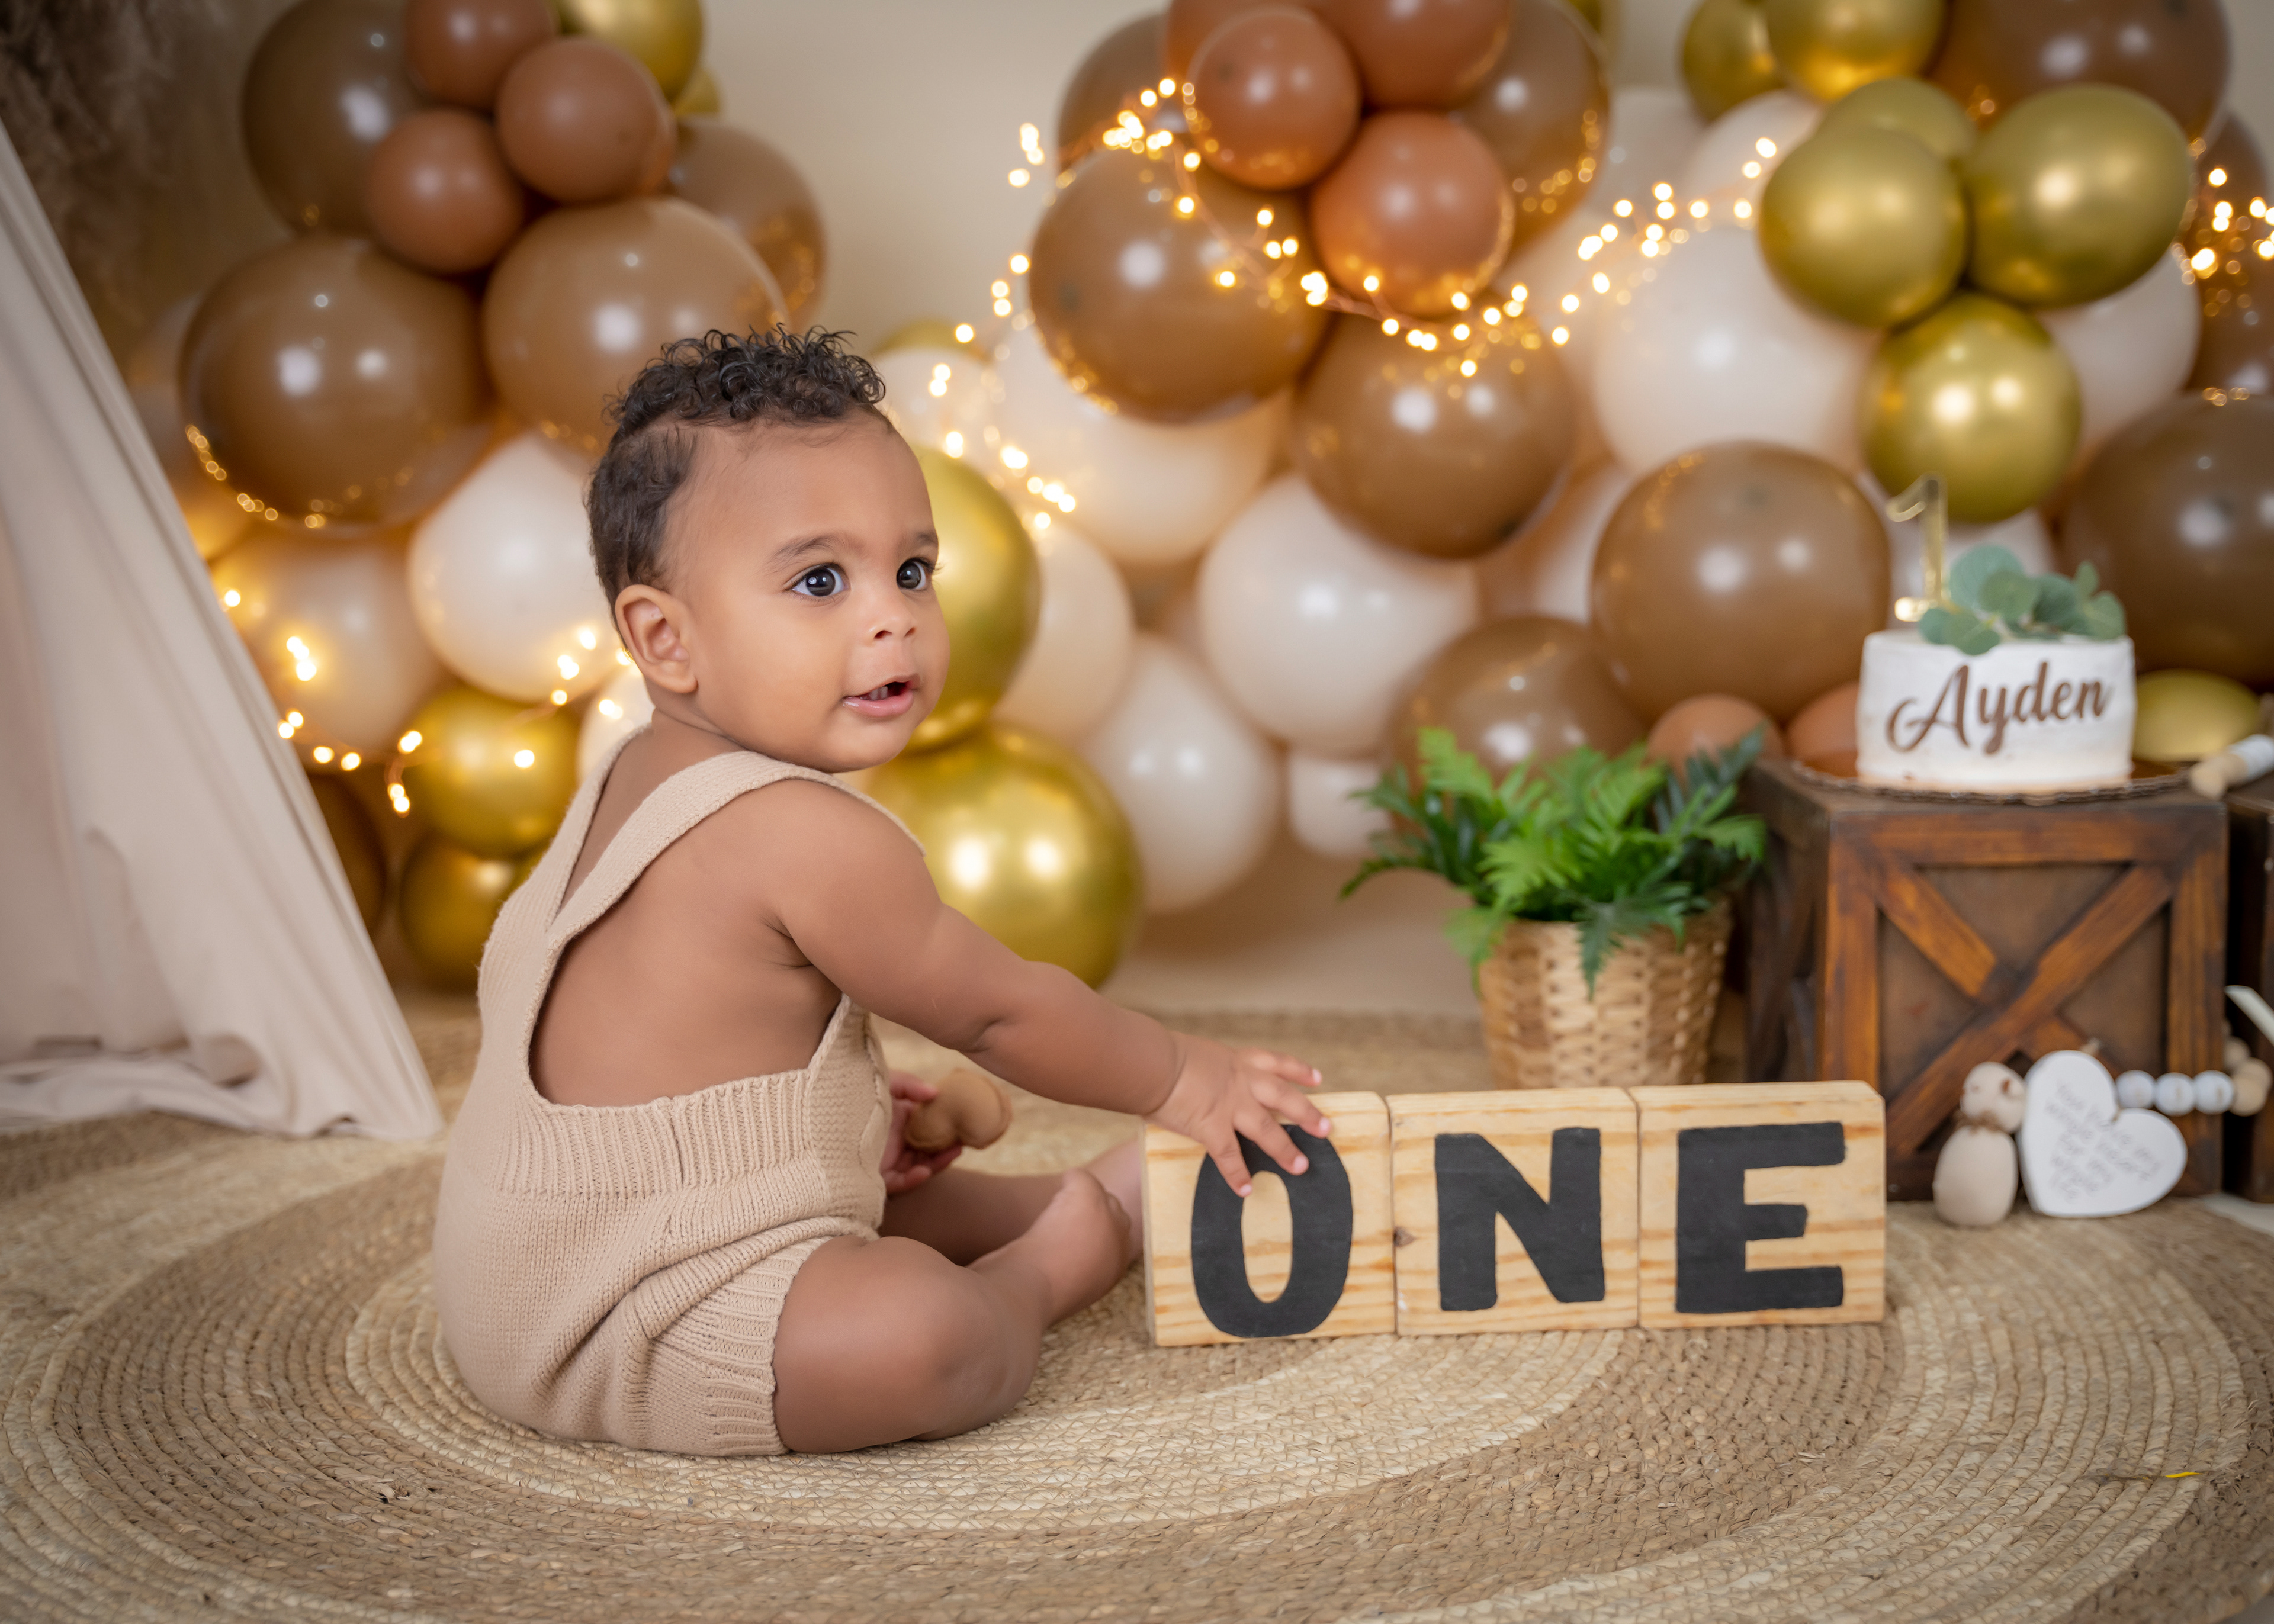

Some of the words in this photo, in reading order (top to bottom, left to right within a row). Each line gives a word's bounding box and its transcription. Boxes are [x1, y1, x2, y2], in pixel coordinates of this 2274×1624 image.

[1887, 474, 1959, 622] 1
[1885, 661, 2113, 755] Ayden
[1191, 1121, 1846, 1339] ONE
